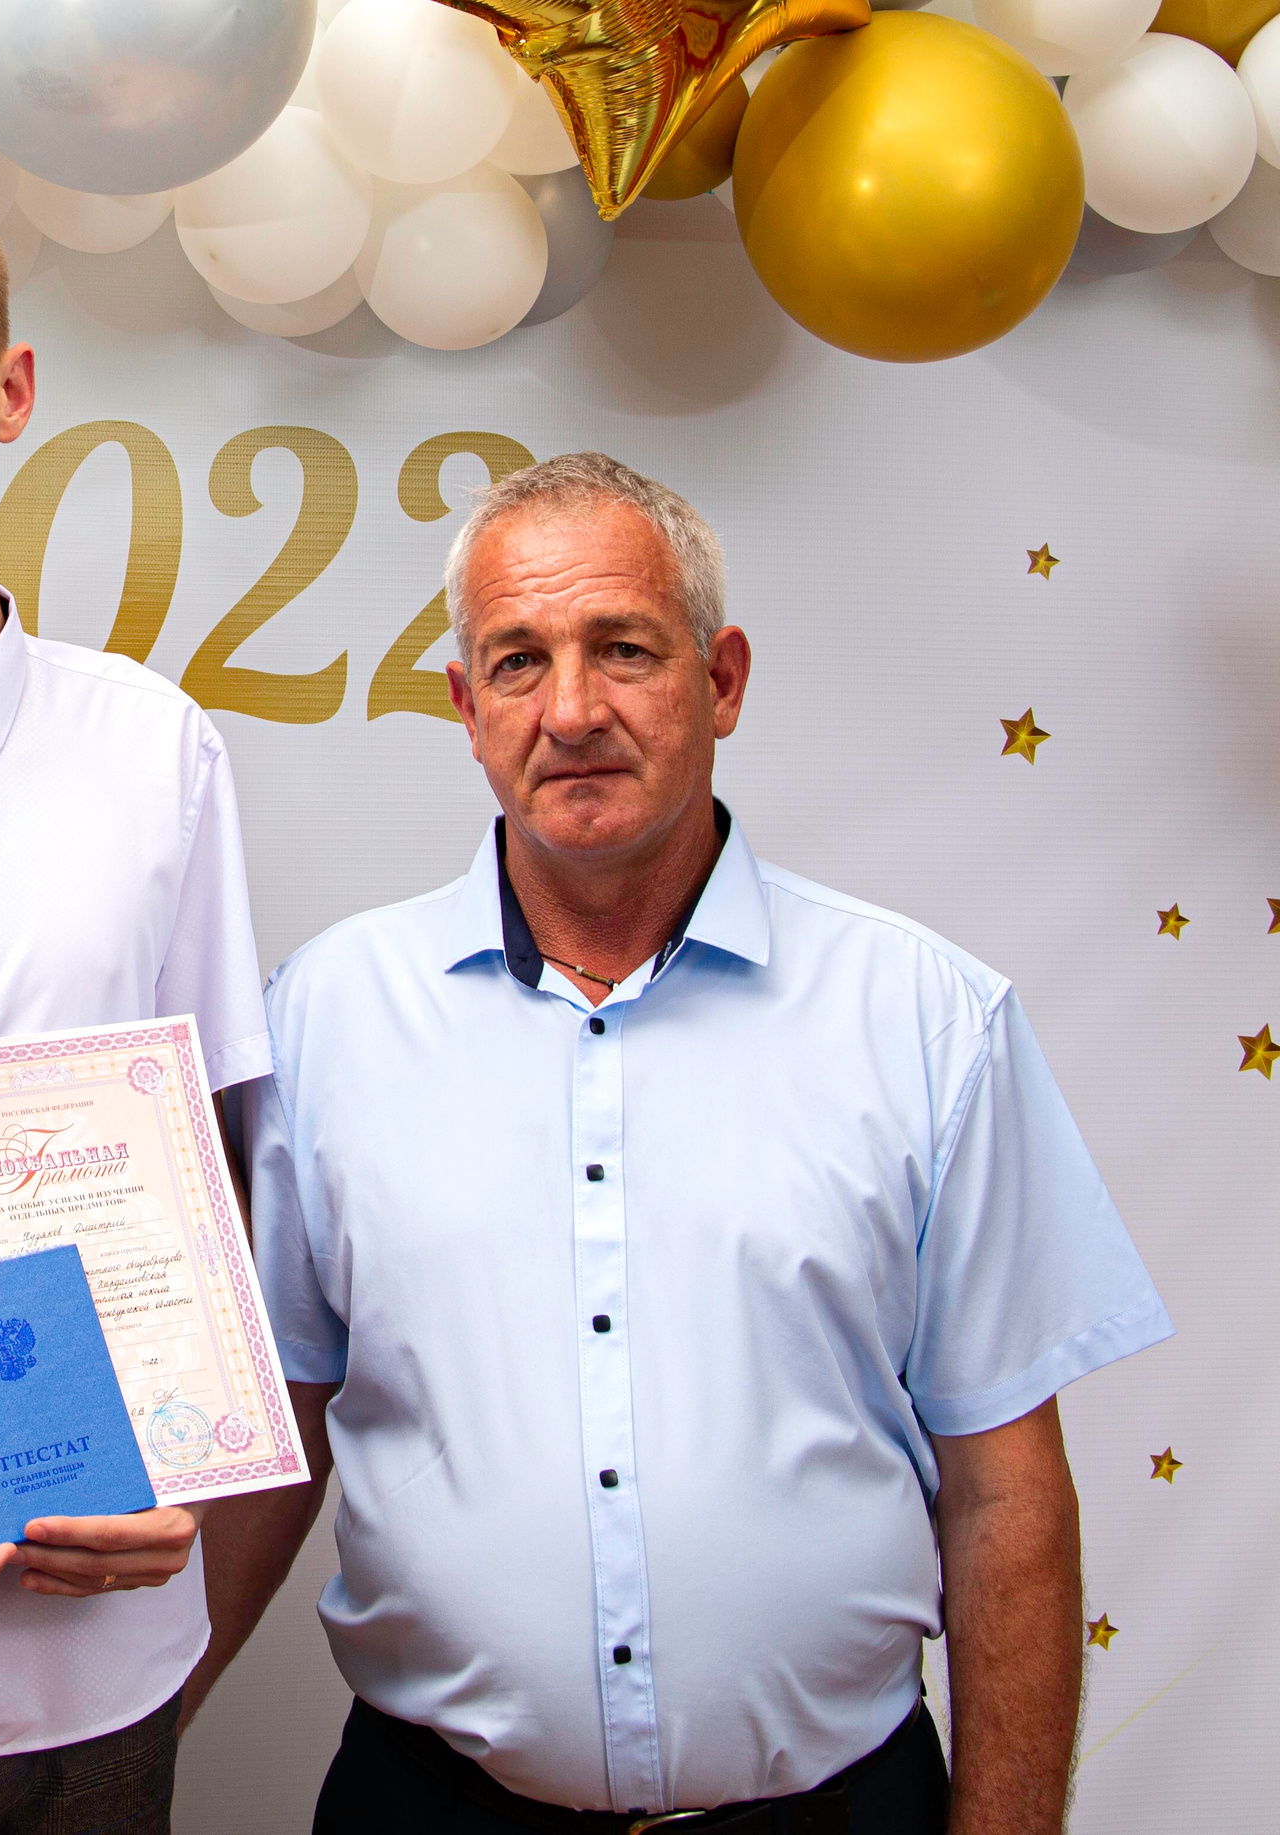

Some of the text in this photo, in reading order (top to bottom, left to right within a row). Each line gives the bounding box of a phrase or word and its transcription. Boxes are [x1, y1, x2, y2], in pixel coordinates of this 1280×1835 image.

[1, 1100, 94, 1118] РОССИЙСКАЯ ФЕДЕРАЦИЯ
[8, 1200, 46, 1212] ОСОБЫЕ
[49, 1194, 86, 1206] УСПЕХИ
[88, 1192, 94, 1200] В
[96, 1185, 144, 1198] ИЗУЧЕНИИ
[10, 1206, 65, 1221] ОТДЕЛЬНЫХ
[1, 1461, 85, 1488] О СРЕДНЕМ ОБЩЕМ
[13, 1473, 78, 1495] ОБРАЗОВАНИИ
